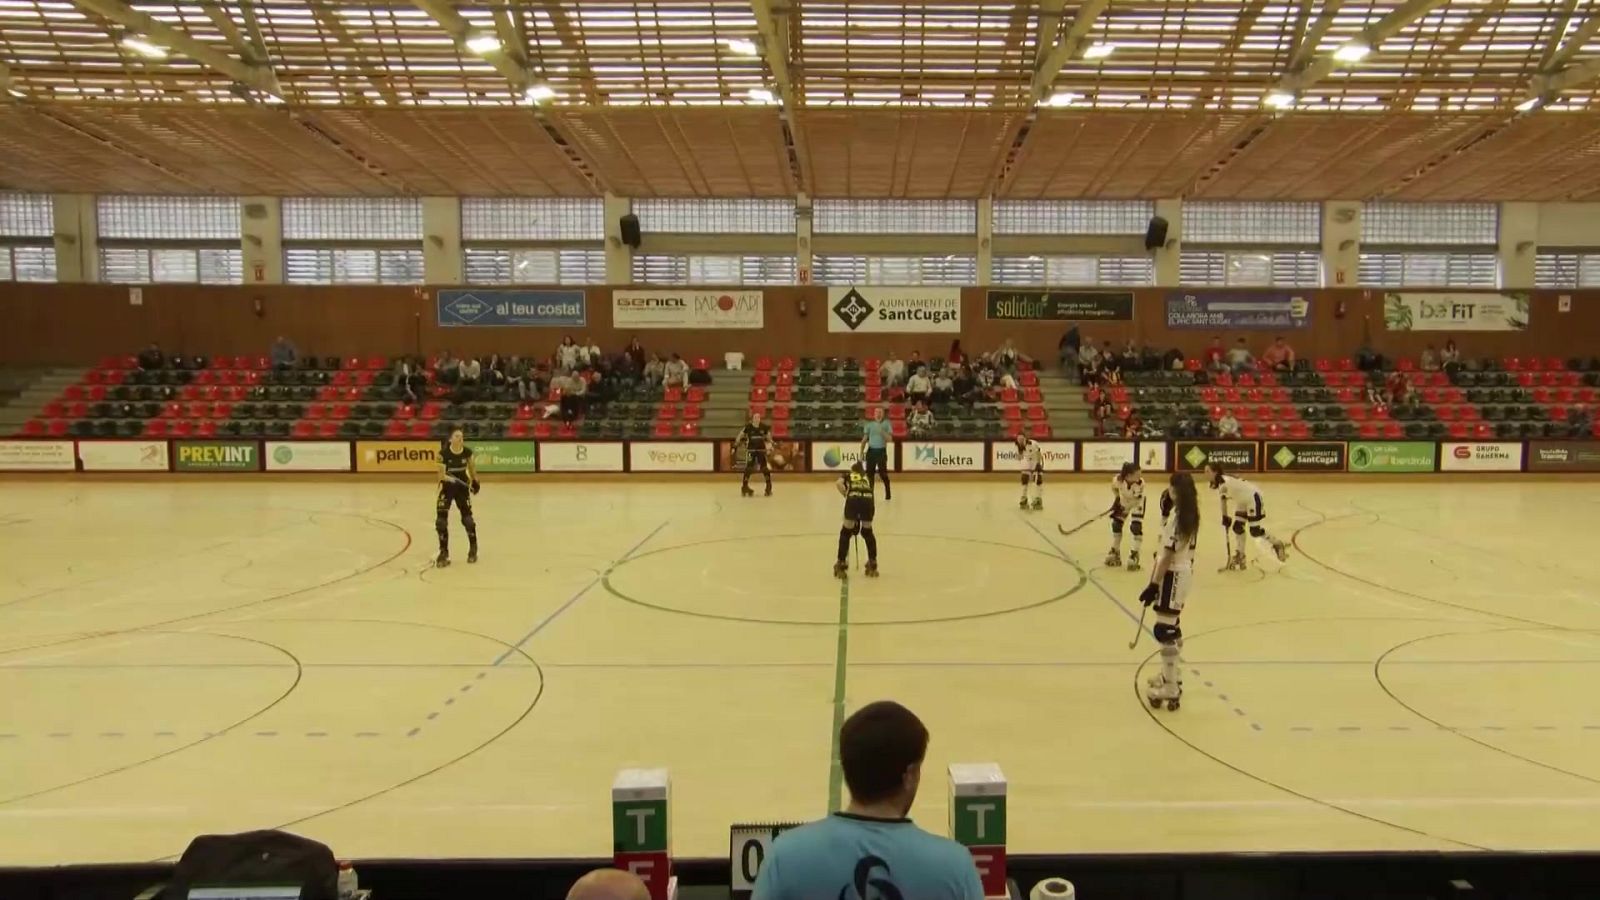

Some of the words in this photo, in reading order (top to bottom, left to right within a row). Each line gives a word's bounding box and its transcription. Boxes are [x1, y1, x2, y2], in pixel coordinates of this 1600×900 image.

[496, 301, 509, 315] al
[512, 303, 534, 315] teu
[537, 302, 581, 316] costat
[879, 299, 941, 308] AJUNTAMENT
[945, 299, 956, 308] DE
[879, 308, 957, 324] SantCugat
[179, 446, 253, 462] PREVINT
[377, 447, 435, 463] parlem
[1208, 456, 1249, 464] SantCugat
[1297, 456, 1338, 464] SantCugat
[626, 808, 656, 845] T
[966, 804, 996, 838] T
[741, 839, 764, 882] 0
